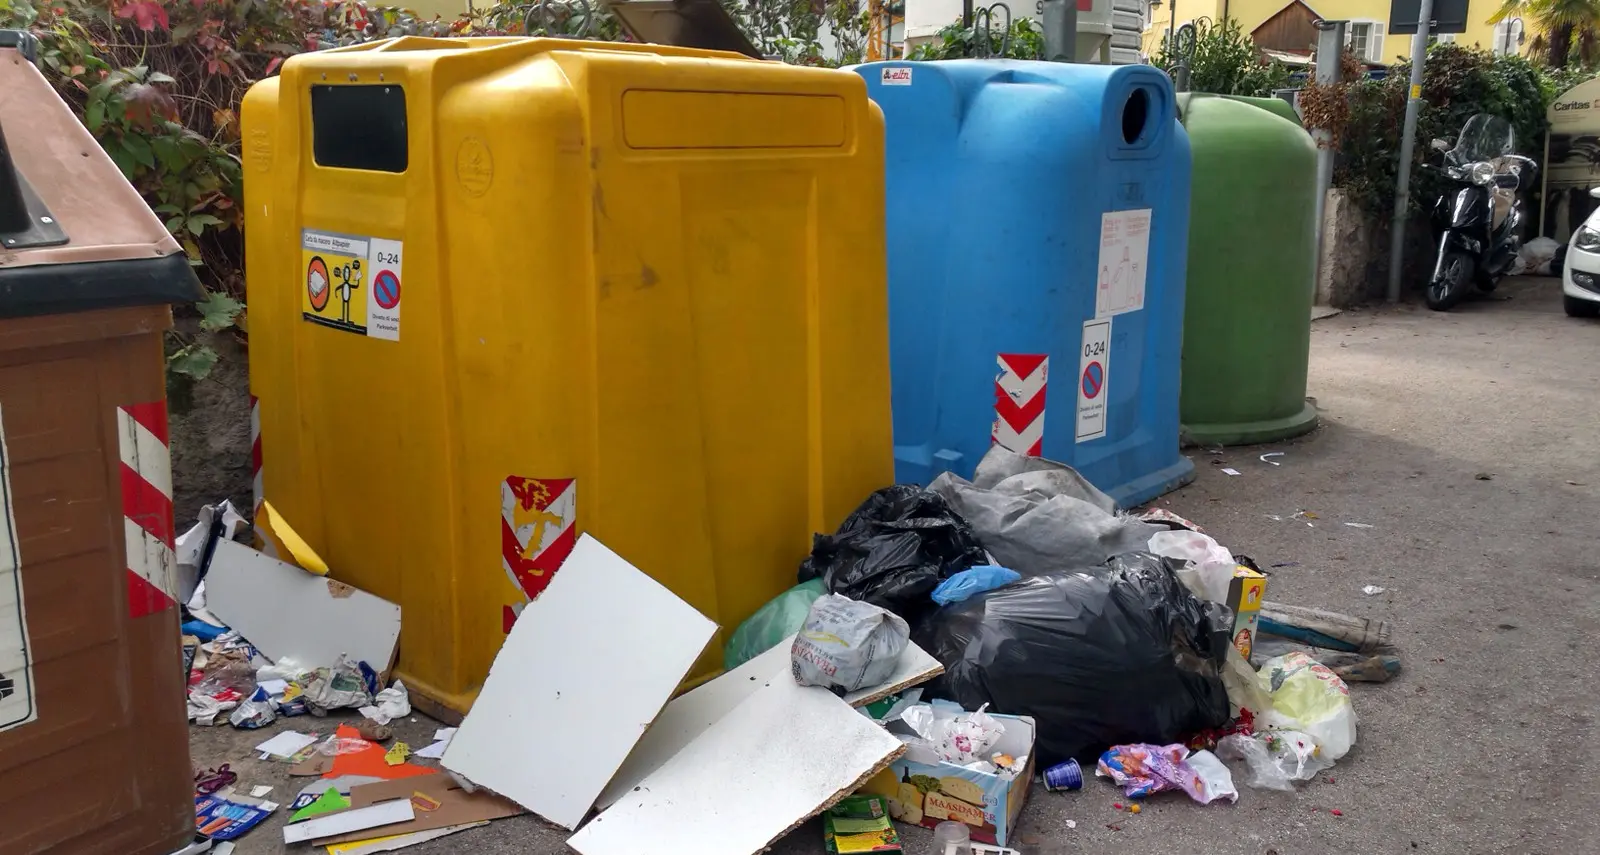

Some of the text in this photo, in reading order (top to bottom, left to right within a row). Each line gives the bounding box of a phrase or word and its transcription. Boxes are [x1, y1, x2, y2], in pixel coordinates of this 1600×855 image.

[1554, 101, 1590, 111] Caritas
[1084, 341, 1105, 357] 0-24
[928, 796, 996, 822] MAASDAMER
